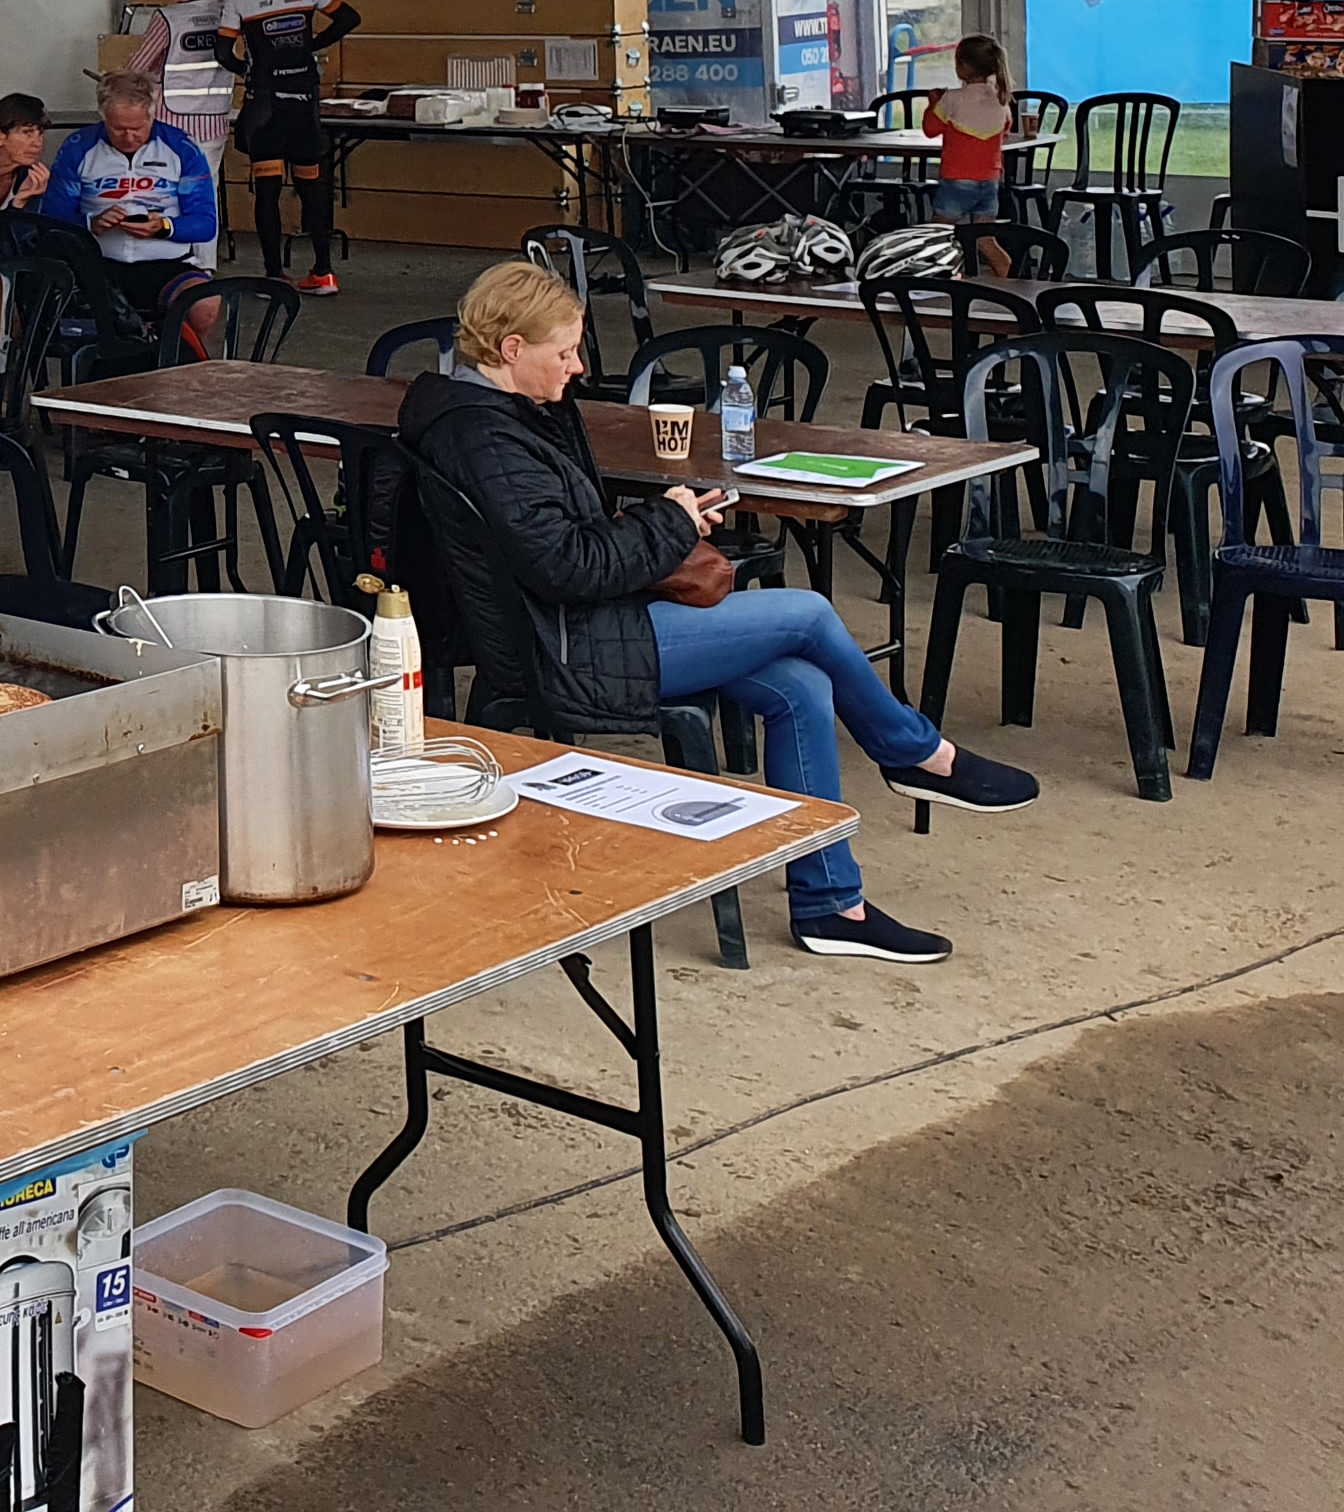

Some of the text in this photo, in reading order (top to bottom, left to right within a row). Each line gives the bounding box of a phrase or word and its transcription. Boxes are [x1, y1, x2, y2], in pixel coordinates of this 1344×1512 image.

[184, 34, 217, 49] CRE
[695, 64, 739, 81] 400
[102, 1269, 127, 1299] 15
